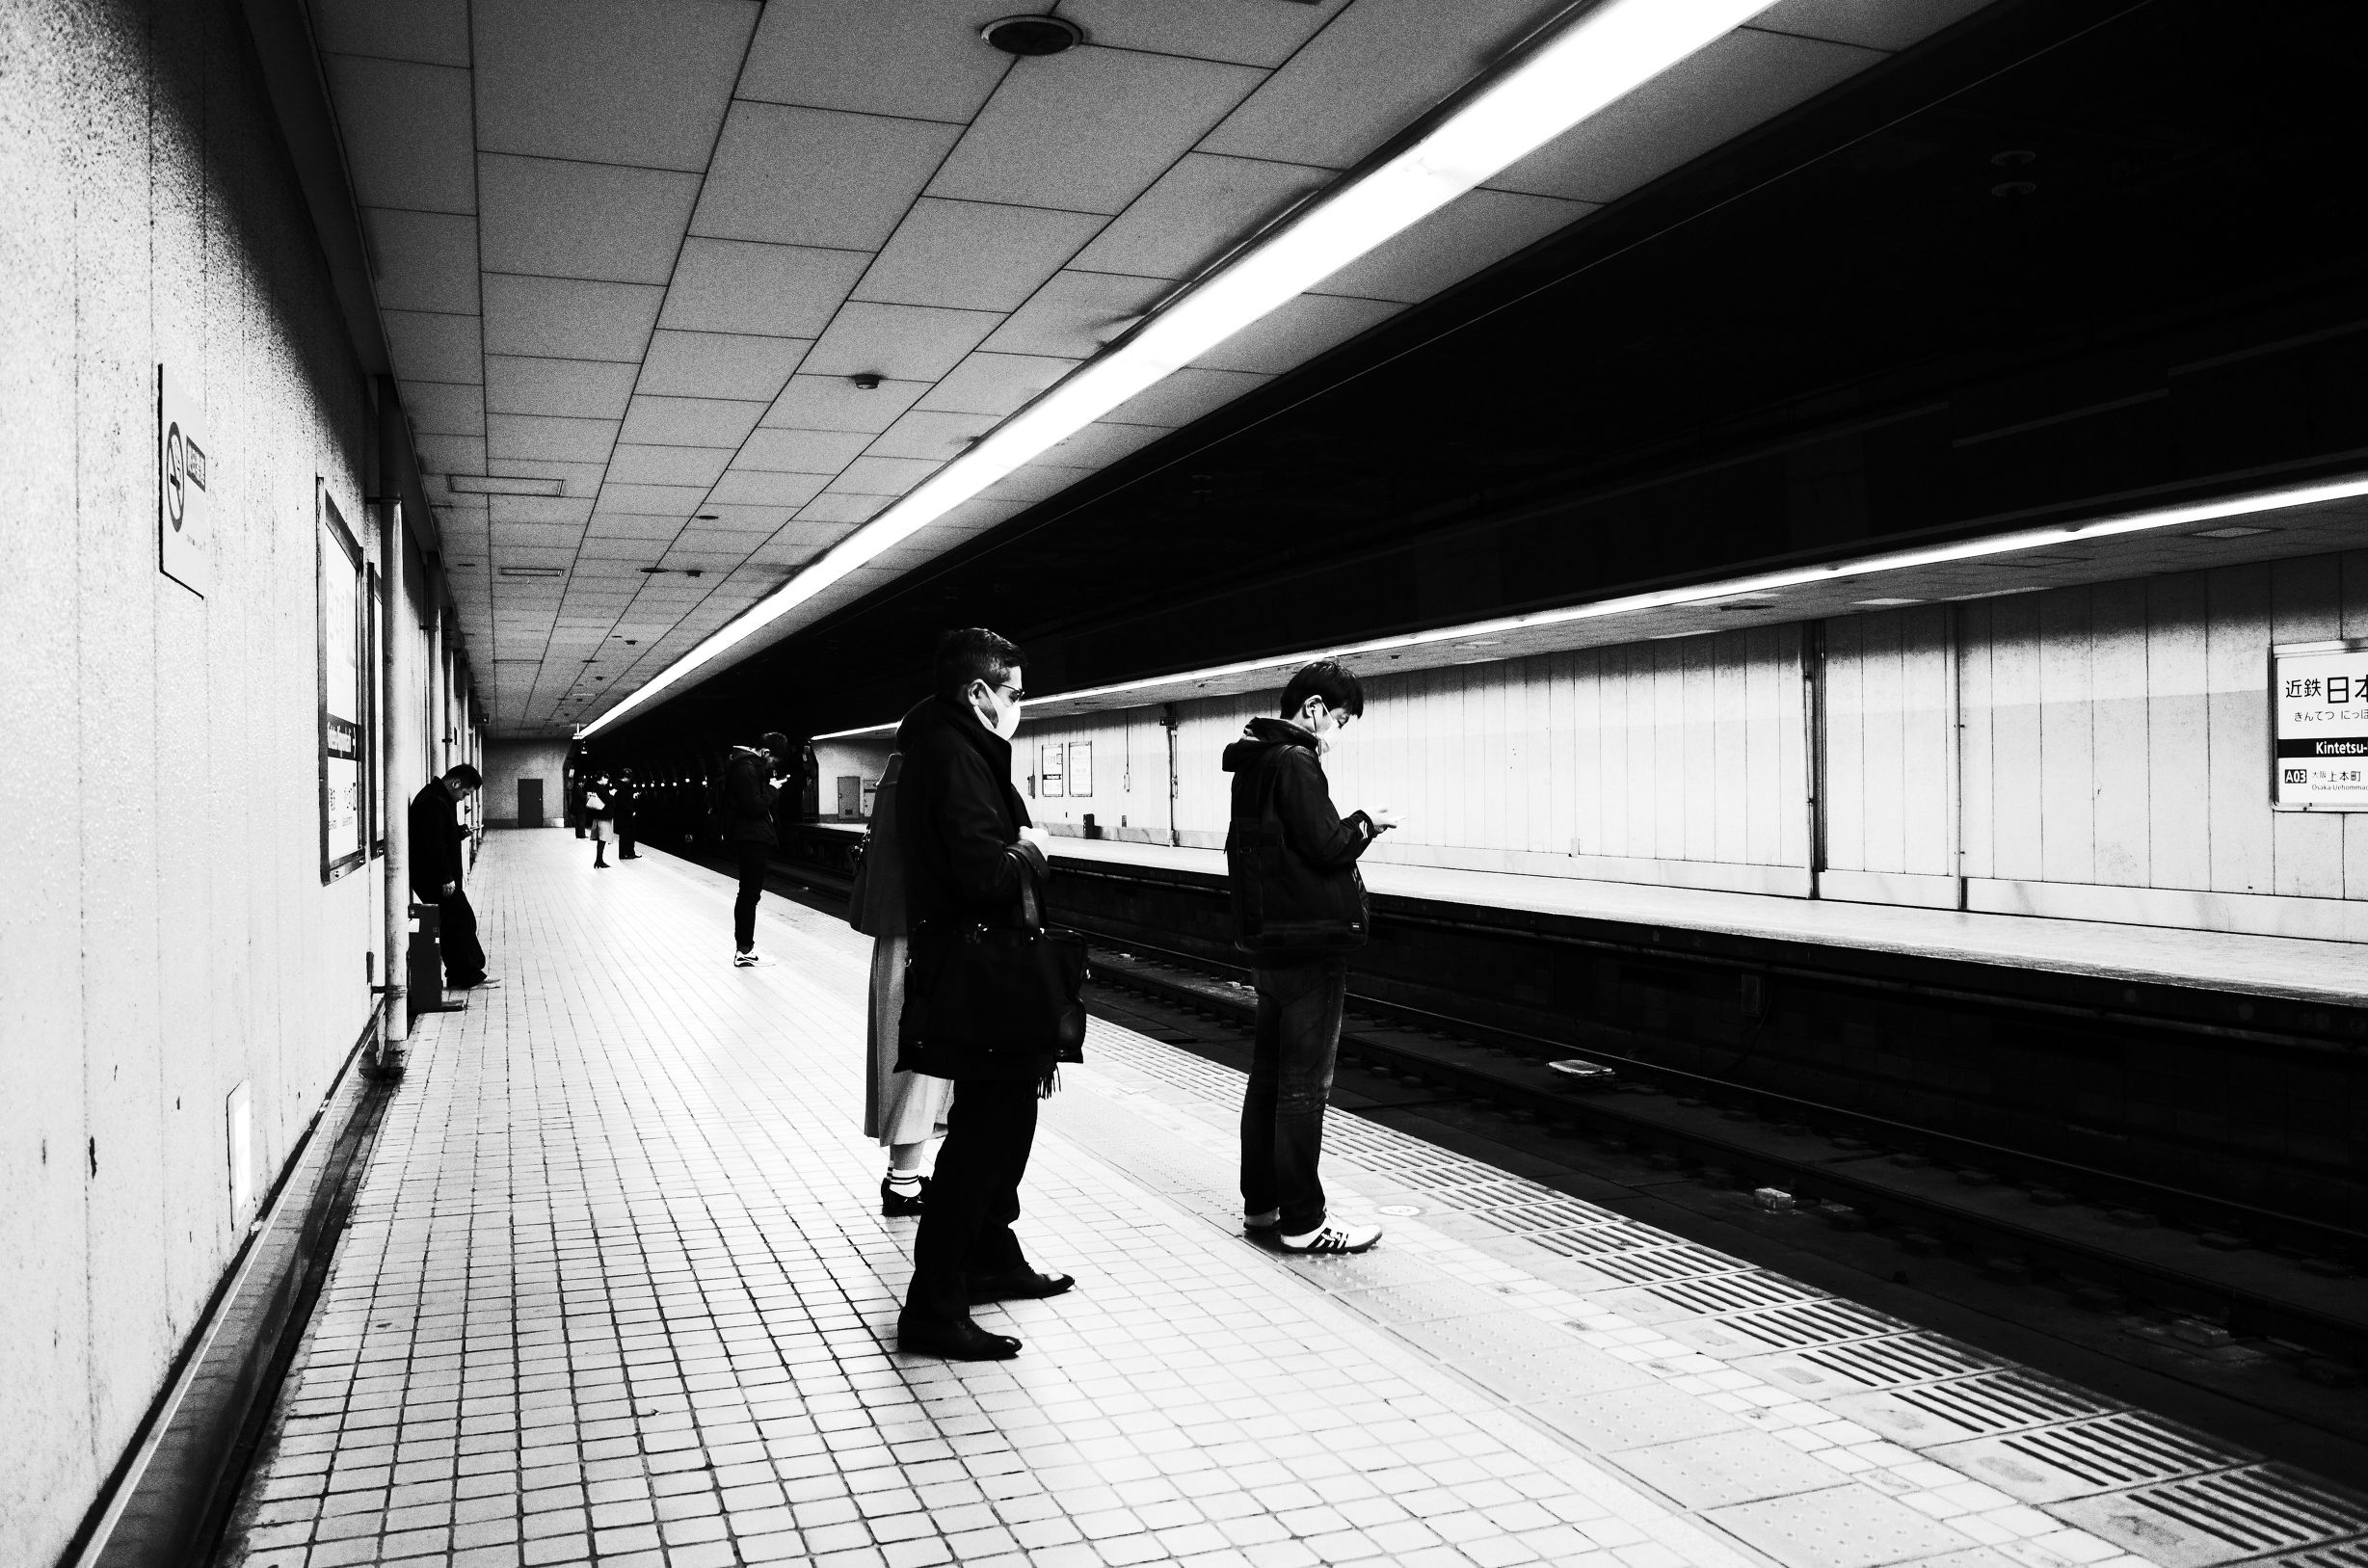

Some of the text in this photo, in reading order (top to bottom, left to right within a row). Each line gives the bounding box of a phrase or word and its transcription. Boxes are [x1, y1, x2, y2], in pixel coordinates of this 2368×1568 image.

[2294, 710, 2335, 723] きんてつ
[2285, 770, 2306, 784] A03
